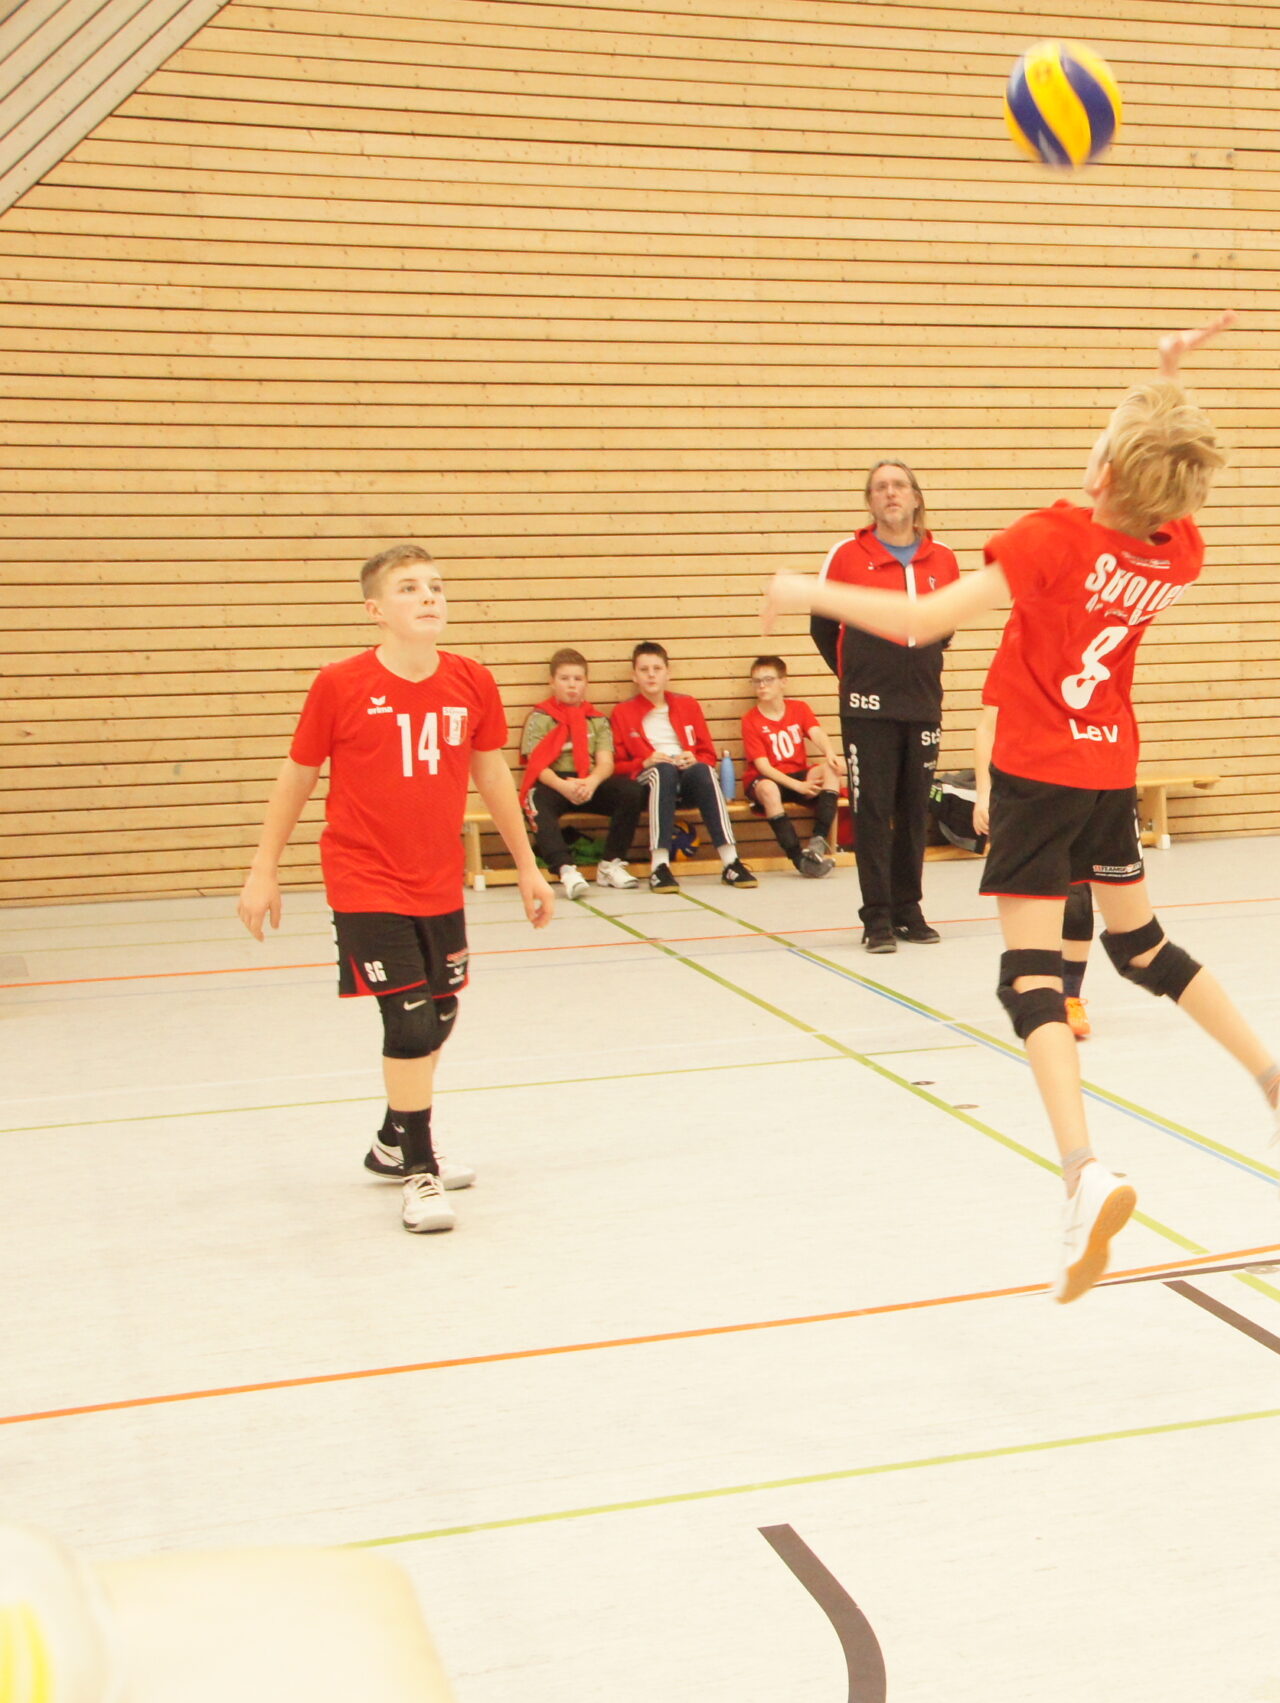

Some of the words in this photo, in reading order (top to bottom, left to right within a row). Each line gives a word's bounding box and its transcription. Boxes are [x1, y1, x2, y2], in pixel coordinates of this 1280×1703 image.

[1061, 626, 1129, 710] 8
[849, 693, 880, 710] StS
[396, 712, 441, 777] 14
[769, 730, 795, 761] 10
